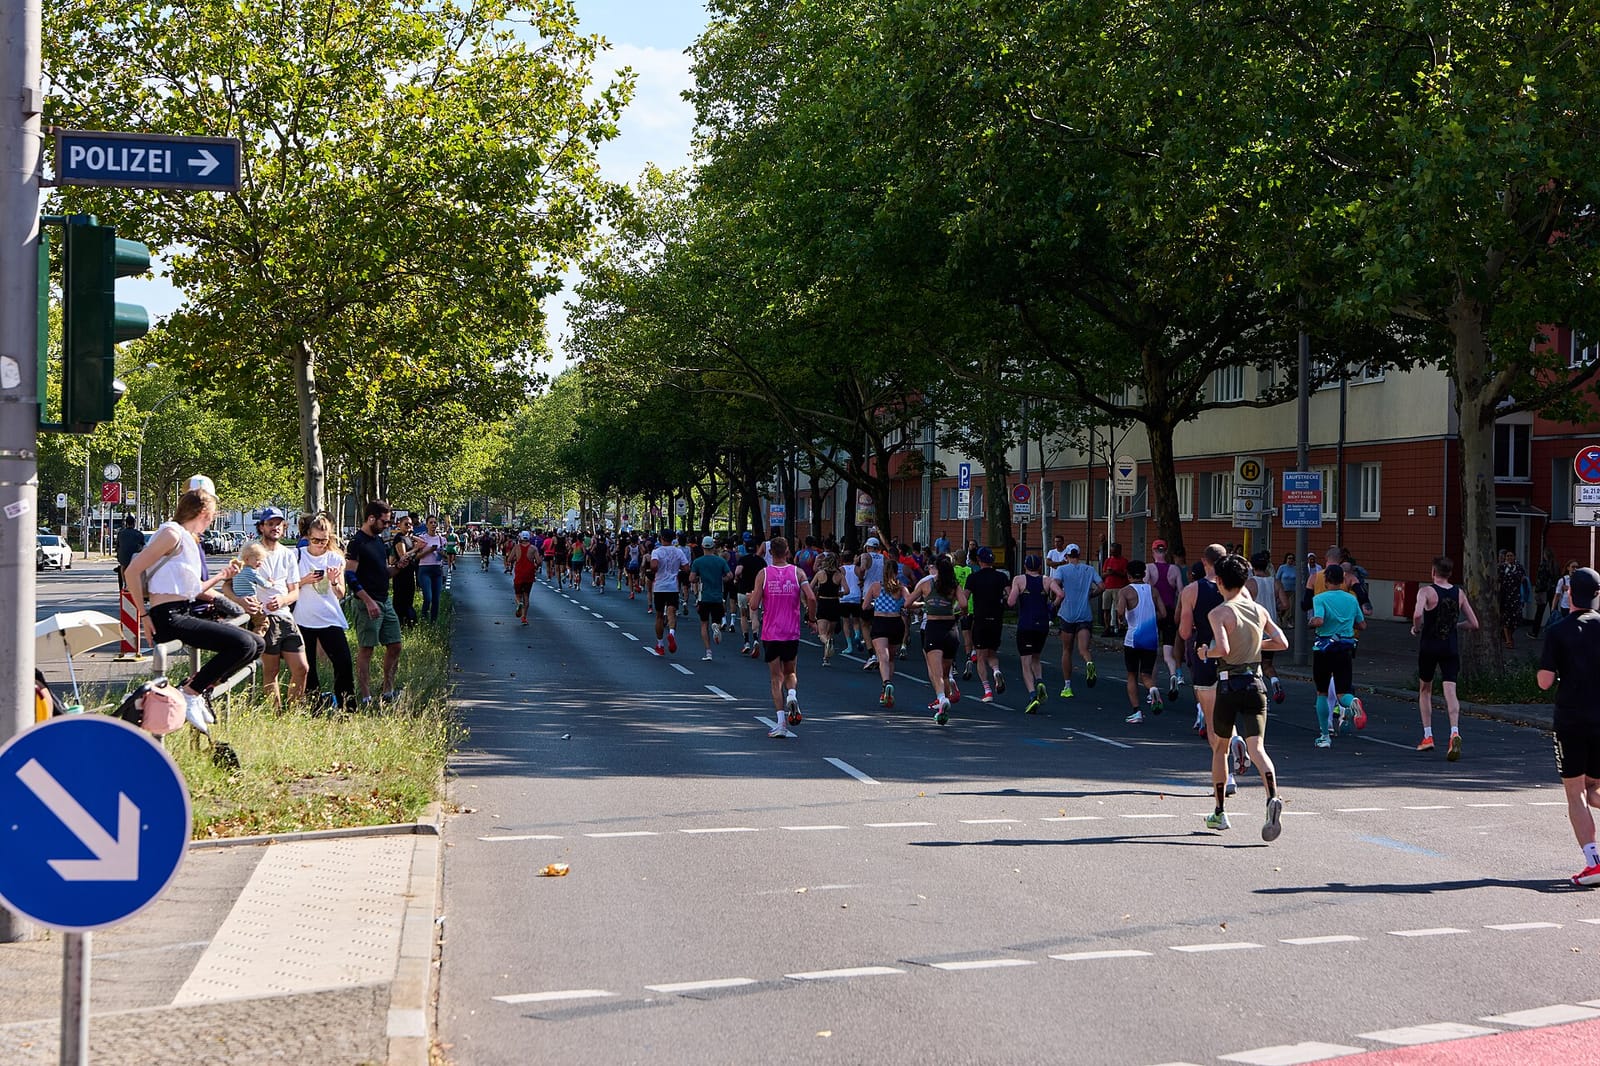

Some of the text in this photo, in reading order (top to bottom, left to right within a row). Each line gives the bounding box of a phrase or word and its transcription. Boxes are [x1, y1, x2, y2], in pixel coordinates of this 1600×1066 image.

[70, 145, 172, 174] POLIZEI
[961, 466, 969, 486] P
[1246, 465, 1255, 476] H
[1554, 745, 1563, 773] TEAM
